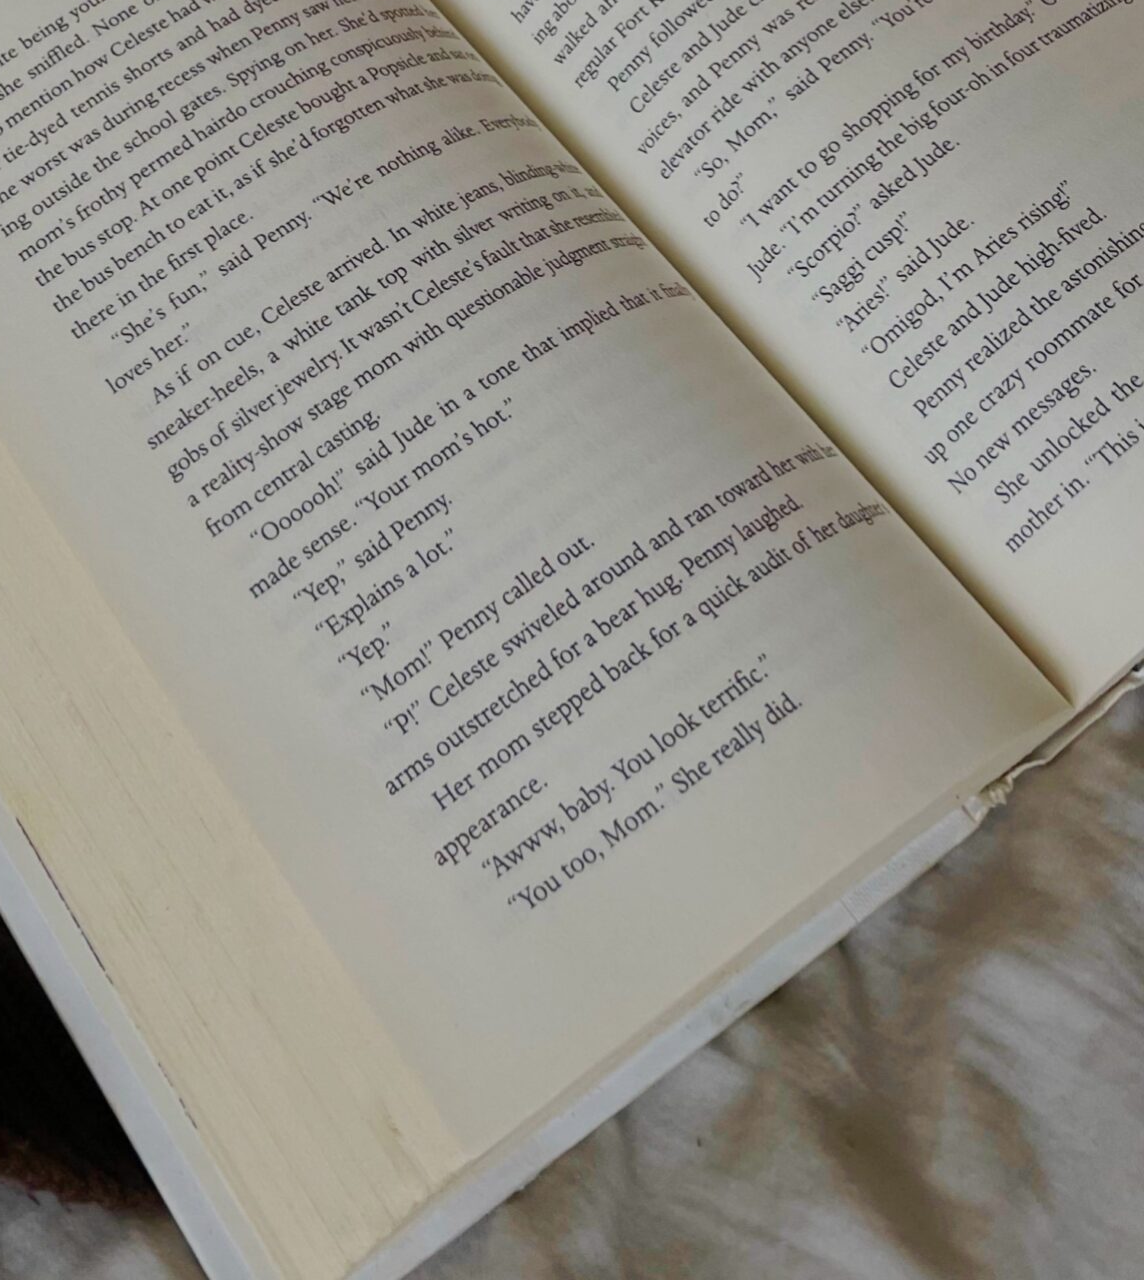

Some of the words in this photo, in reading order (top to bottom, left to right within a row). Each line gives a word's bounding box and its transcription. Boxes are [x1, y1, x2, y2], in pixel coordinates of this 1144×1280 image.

[17, 15, 70, 50] being
[26, 33, 91, 80] sniffled.
[90, 4, 140, 37] None
[606, 45, 653, 93] Penny
[629, 62, 682, 114] Celeste
[681, 30, 713, 64] and
[707, 5, 748, 43] Jude
[70, 303, 118, 340] there
[115, 289, 139, 308] in
[137, 268, 169, 293] the
[166, 242, 205, 272] first
[202, 212, 255, 252] place.
[152, 381, 177, 406] As
[175, 362, 193, 387] if
[196, 350, 223, 372] on
[223, 326, 262, 353] cue,
[260, 280, 325, 325] Celeste
[326, 236, 390, 284] arrived.
[386, 226, 413, 243] In
[410, 200, 460, 229] white
[456, 181, 505, 211] jeans,
[888, 334, 949, 389] Celeste
[947, 300, 983, 337] and
[975, 272, 1021, 315] Jude
[1013, 206, 1108, 277] high-fived.
[946, 466, 978, 495] No
[975, 431, 1011, 471] new
[1011, 364, 1098, 437] messages.
[993, 472, 1030, 505] She
[1029, 396, 1112, 473] unlocked
[1110, 374, 1144, 403] the
[204, 500, 254, 539] from
[253, 449, 316, 503] central
[315, 410, 381, 459] casting.
[677, 534, 739, 578] Penny
[731, 493, 805, 542] laughed.
[590, 600, 640, 637] bear
[633, 573, 684, 608] hug.
[430, 773, 476, 812] Her
[476, 733, 532, 780] mom
[531, 671, 607, 739] stepped
[599, 641, 654, 683] back
[648, 621, 682, 650] for
[682, 612, 698, 628] a
[697, 574, 750, 620] quick
[747, 548, 793, 583] audit
[791, 529, 813, 555] of
[805, 521, 840, 544] her
[549, 641, 583, 671] for
[583, 632, 599, 648] a
[436, 658, 554, 757] outstretched
[384, 752, 436, 797] arms
[433, 778, 549, 867] appearance.
